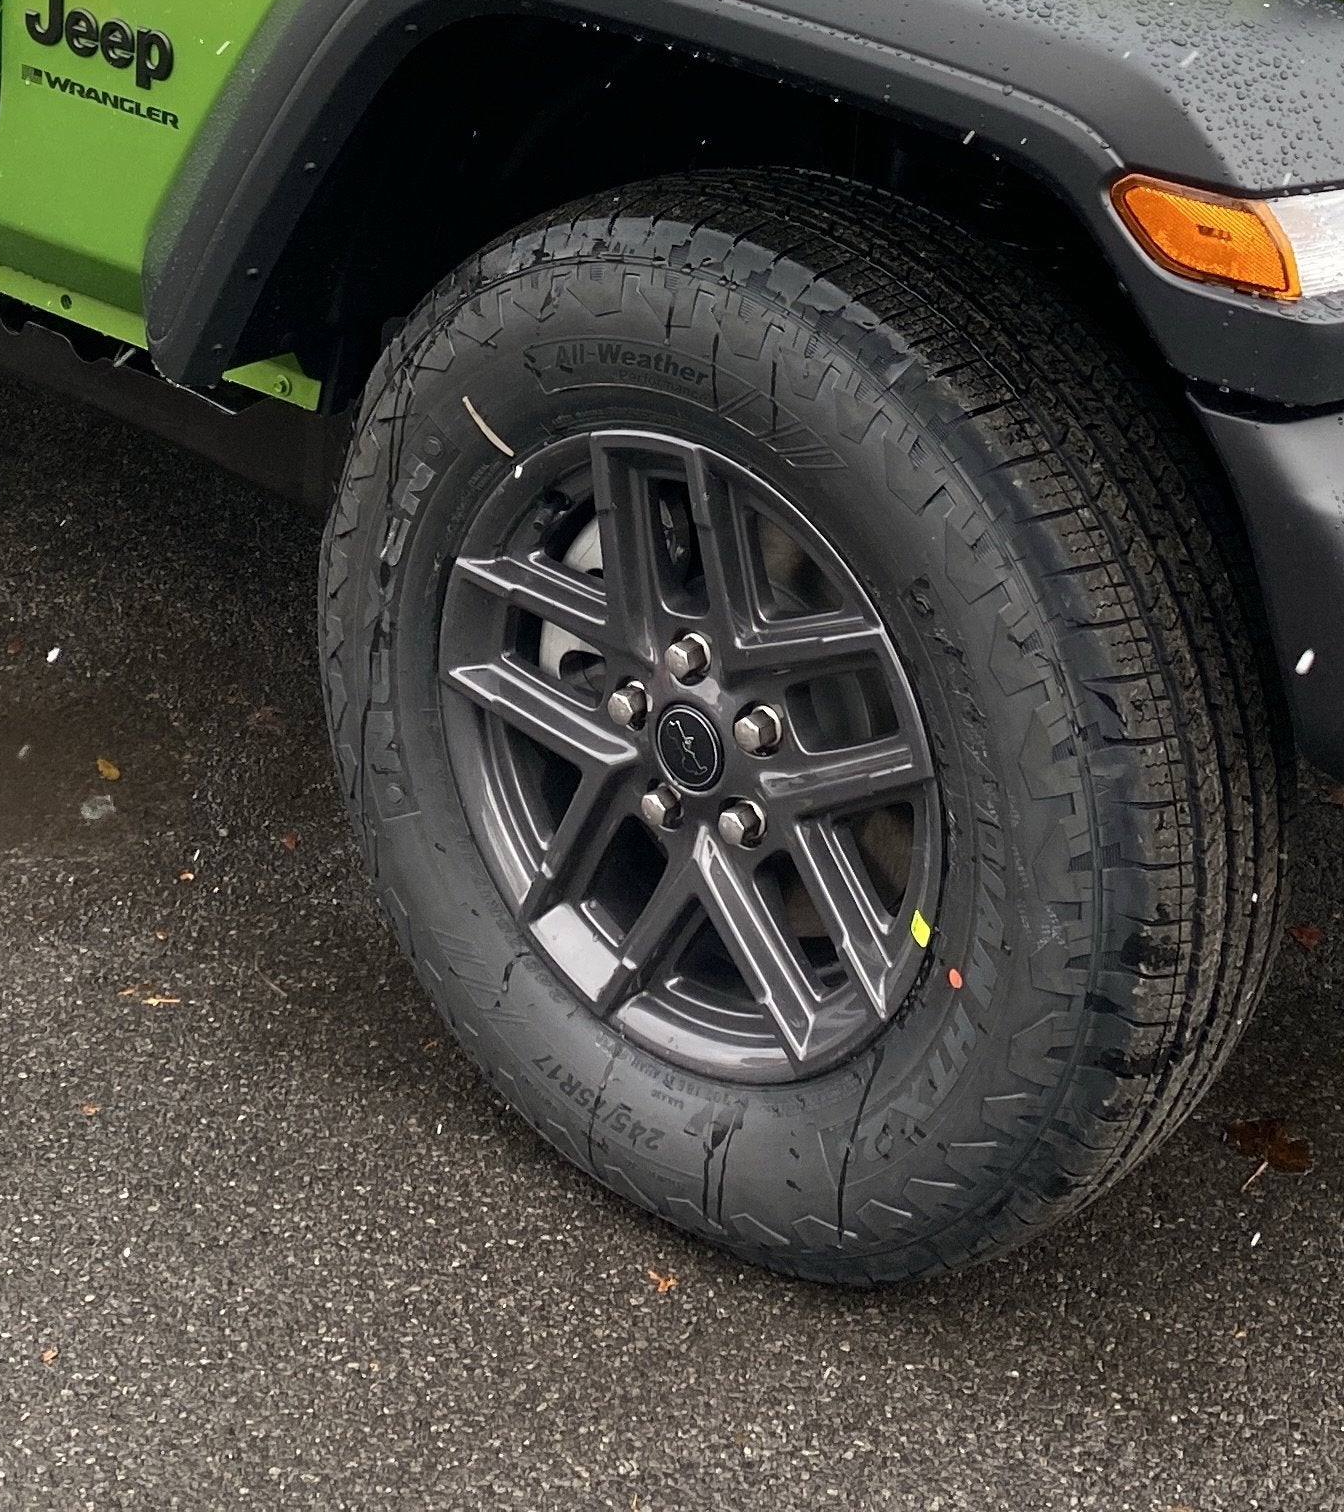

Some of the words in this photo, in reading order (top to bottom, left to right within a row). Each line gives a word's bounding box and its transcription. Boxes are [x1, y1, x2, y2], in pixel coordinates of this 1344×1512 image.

[44, 70, 180, 130] WRANGLER
[557, 343, 709, 387] All-Weather
[531, 1054, 666, 1151] 245/75R17
